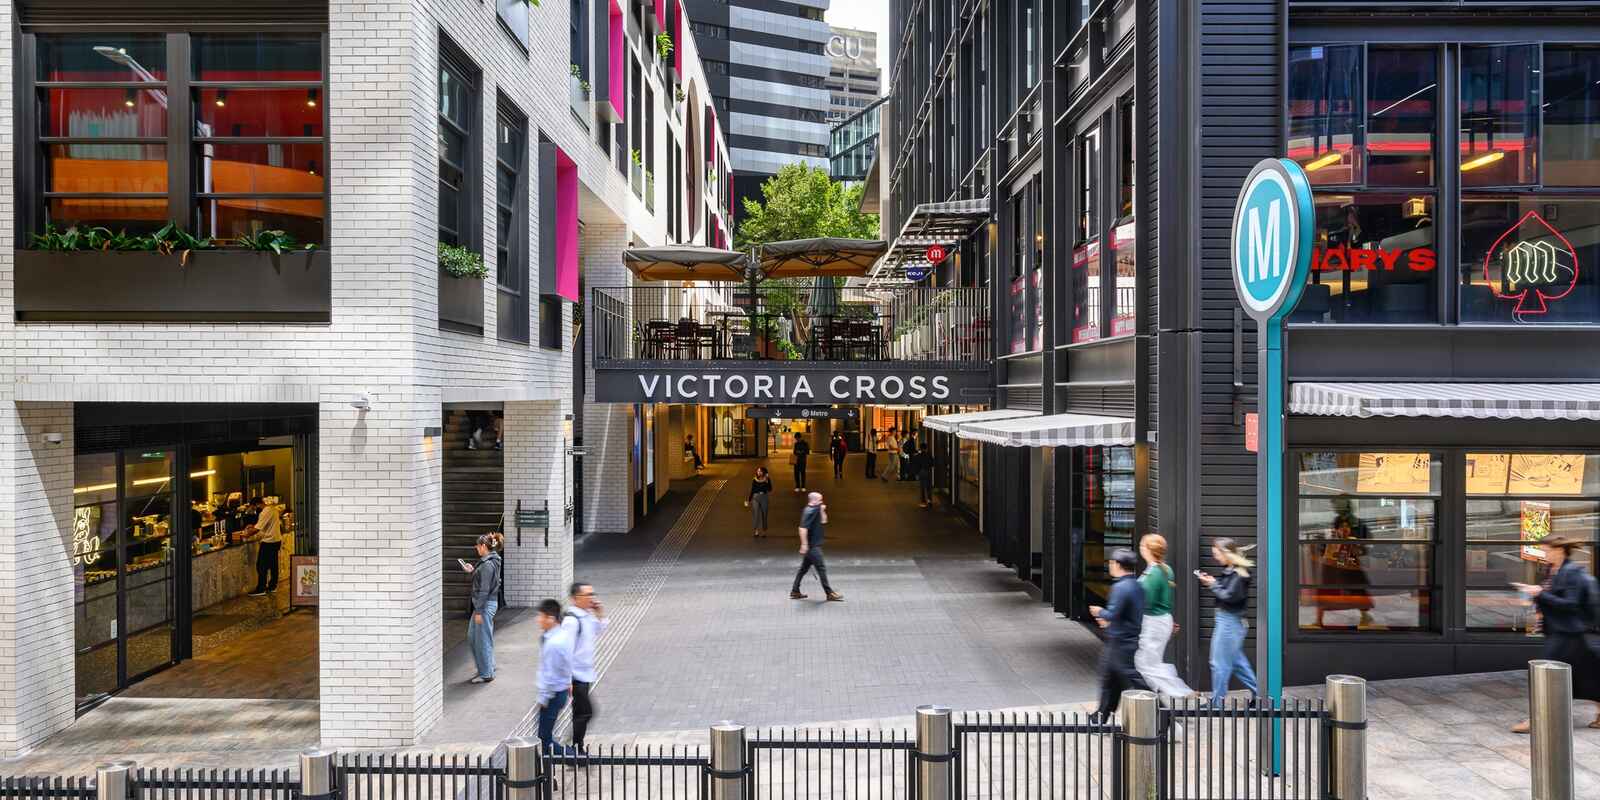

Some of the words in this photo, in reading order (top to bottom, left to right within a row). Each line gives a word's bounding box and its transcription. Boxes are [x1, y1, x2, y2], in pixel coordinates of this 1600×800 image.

[1248, 198, 1281, 283] M
[638, 374, 814, 398] VICTORIA
[829, 374, 950, 398] CROSS
